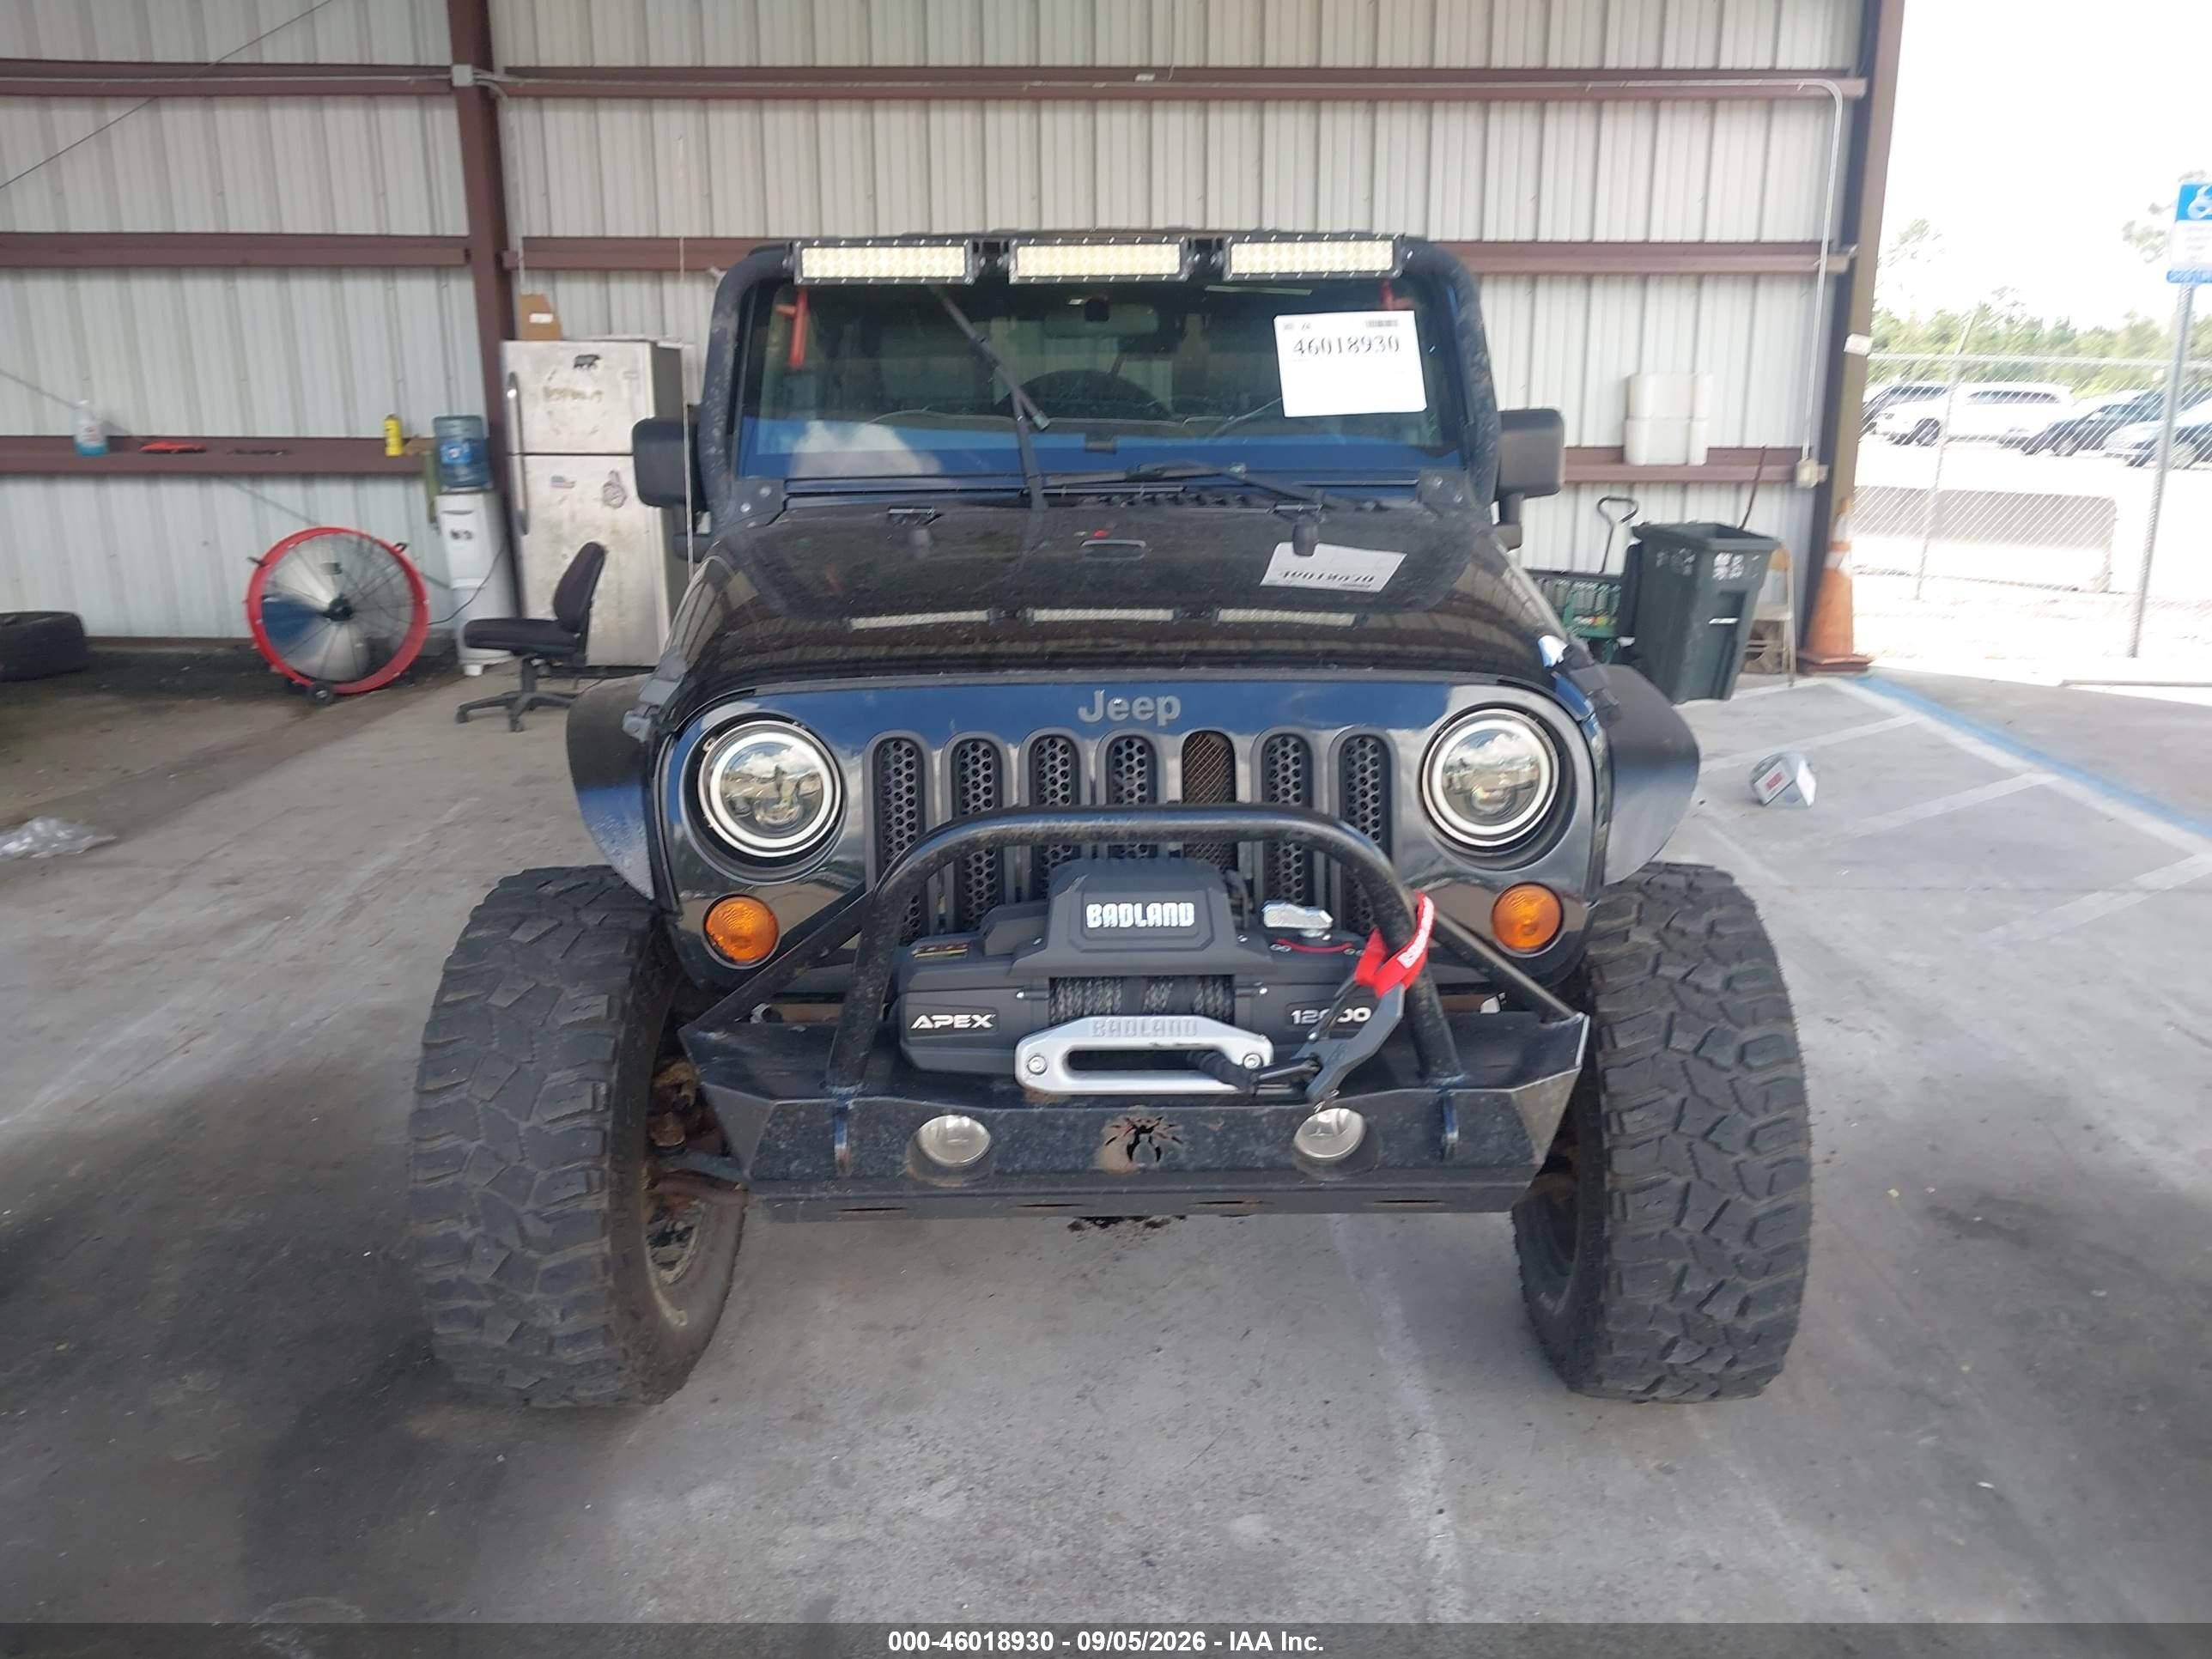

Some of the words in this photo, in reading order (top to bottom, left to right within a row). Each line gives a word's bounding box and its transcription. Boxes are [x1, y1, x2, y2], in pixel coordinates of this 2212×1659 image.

[1292, 334, 1400, 356] 46018930
[1078, 690, 1181, 726] Jeep
[1086, 902, 1195, 928] BADLAND
[910, 1014, 996, 1030] APEX
[1091, 1018, 1198, 1038] BADLAND
